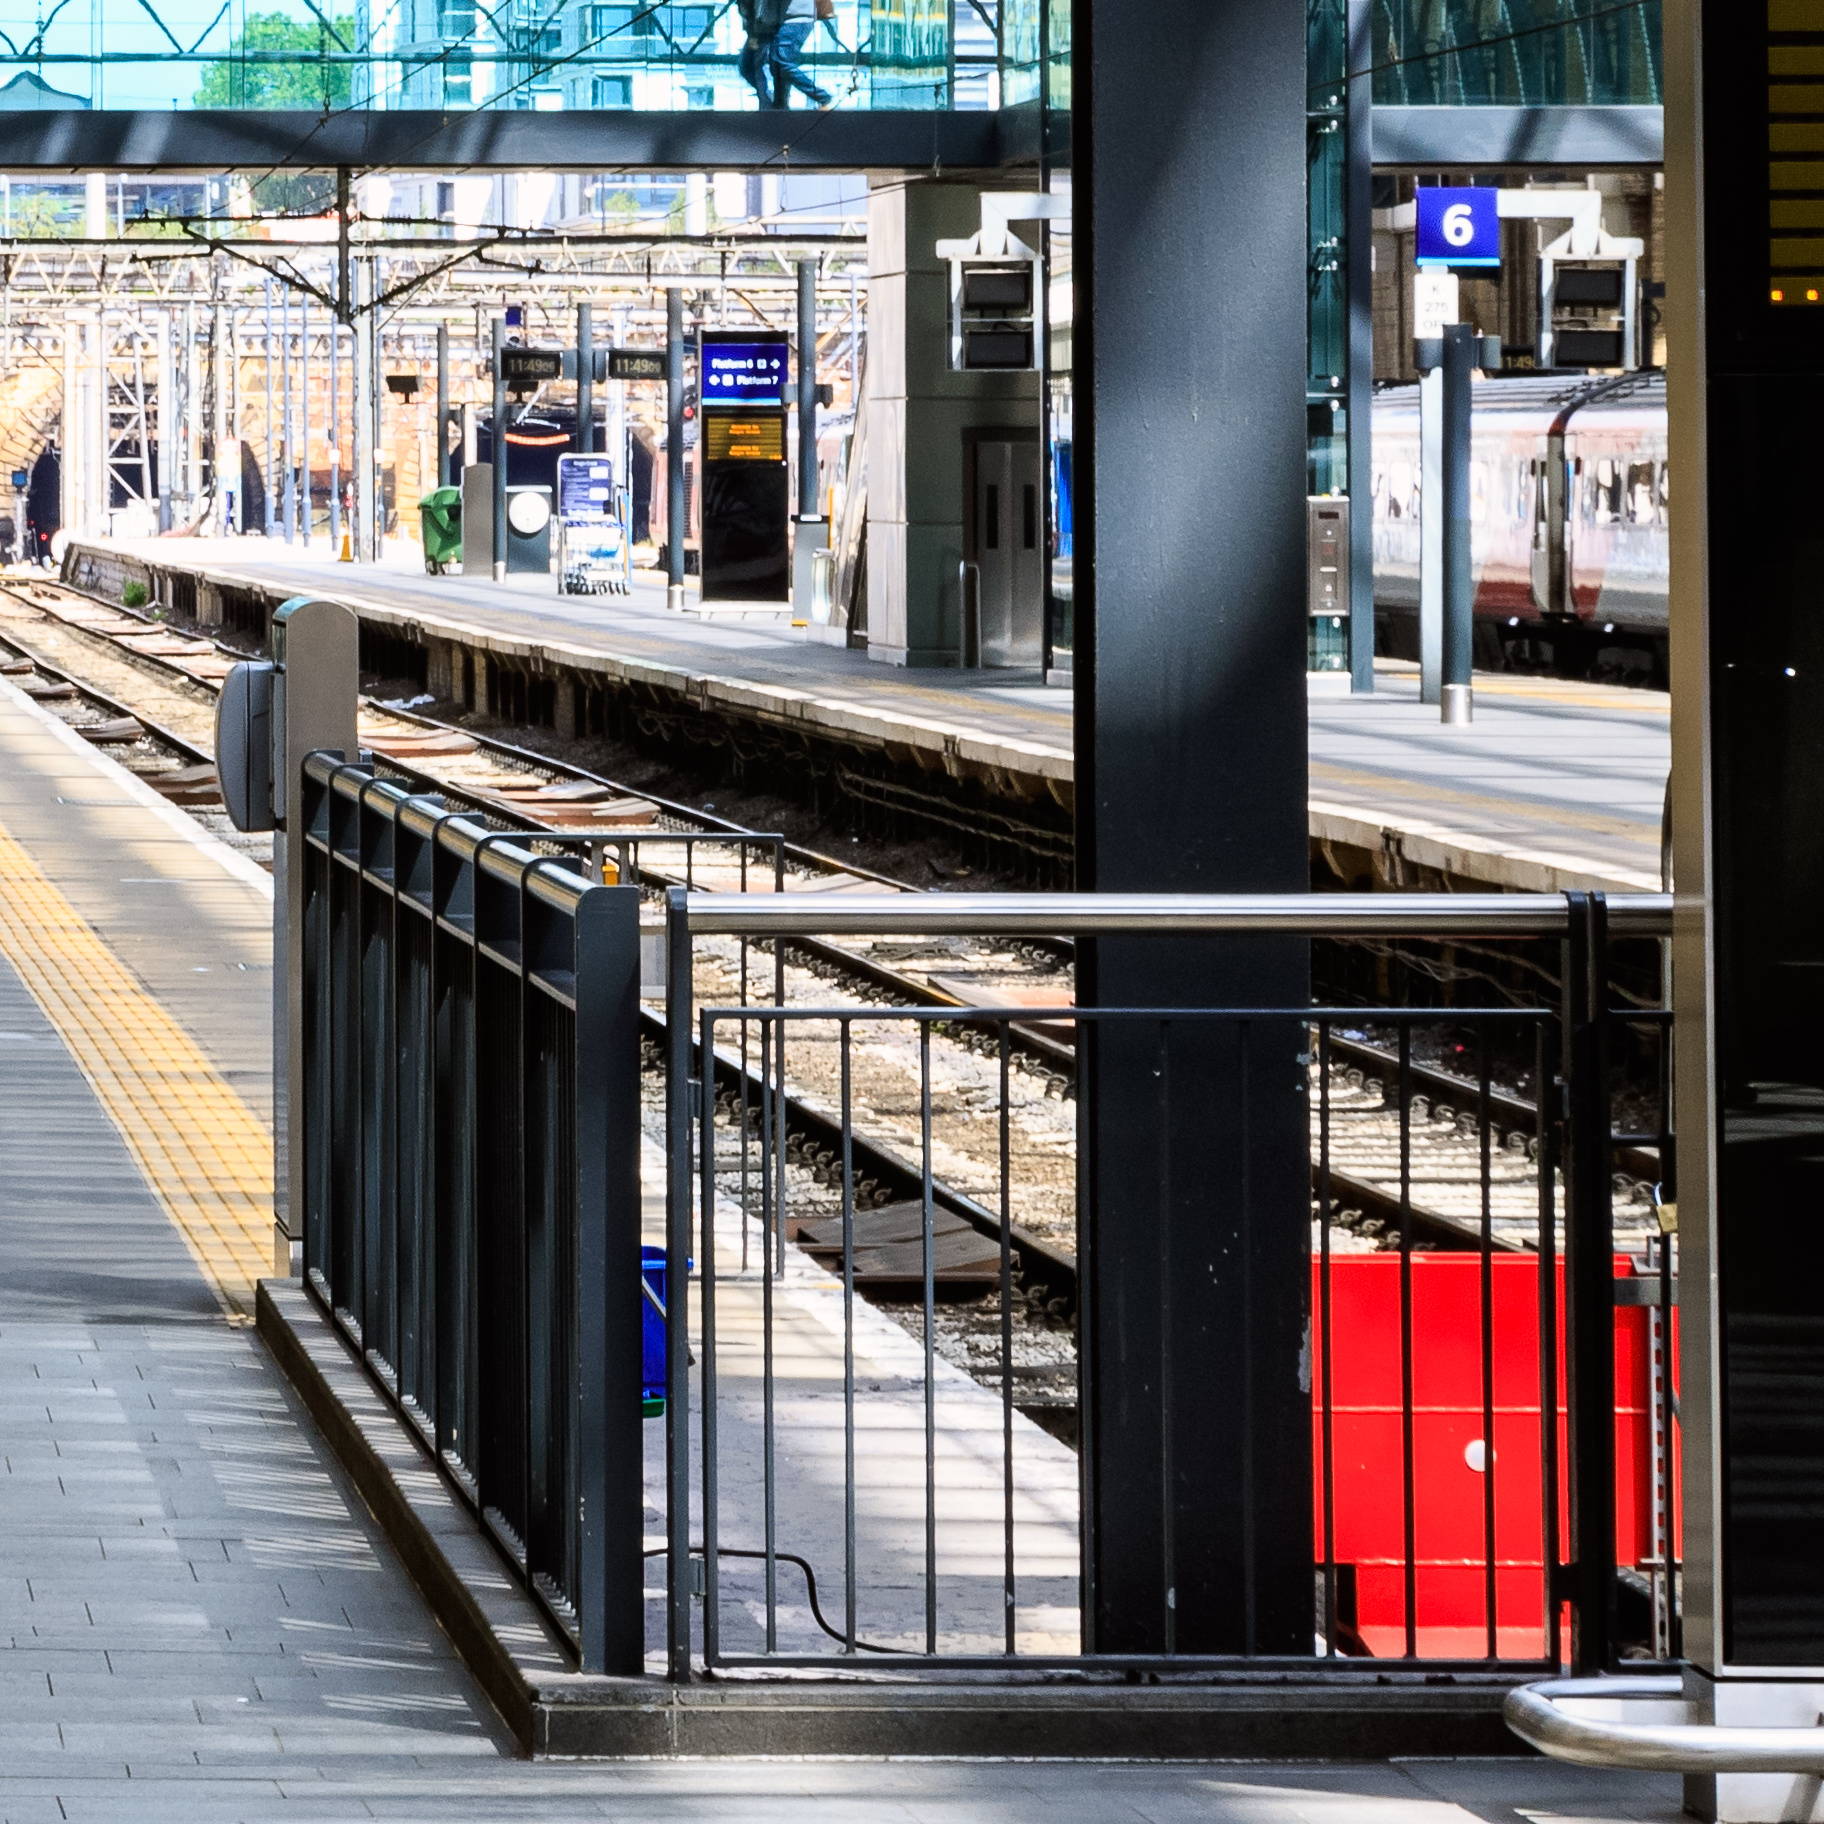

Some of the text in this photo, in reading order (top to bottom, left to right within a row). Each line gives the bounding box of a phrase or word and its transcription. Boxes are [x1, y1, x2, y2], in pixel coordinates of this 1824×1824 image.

[1443, 204, 1474, 247] 6
[1432, 285, 1440, 294] K
[1425, 302, 1449, 313] 275
[1423, 320, 1449, 331] OF
